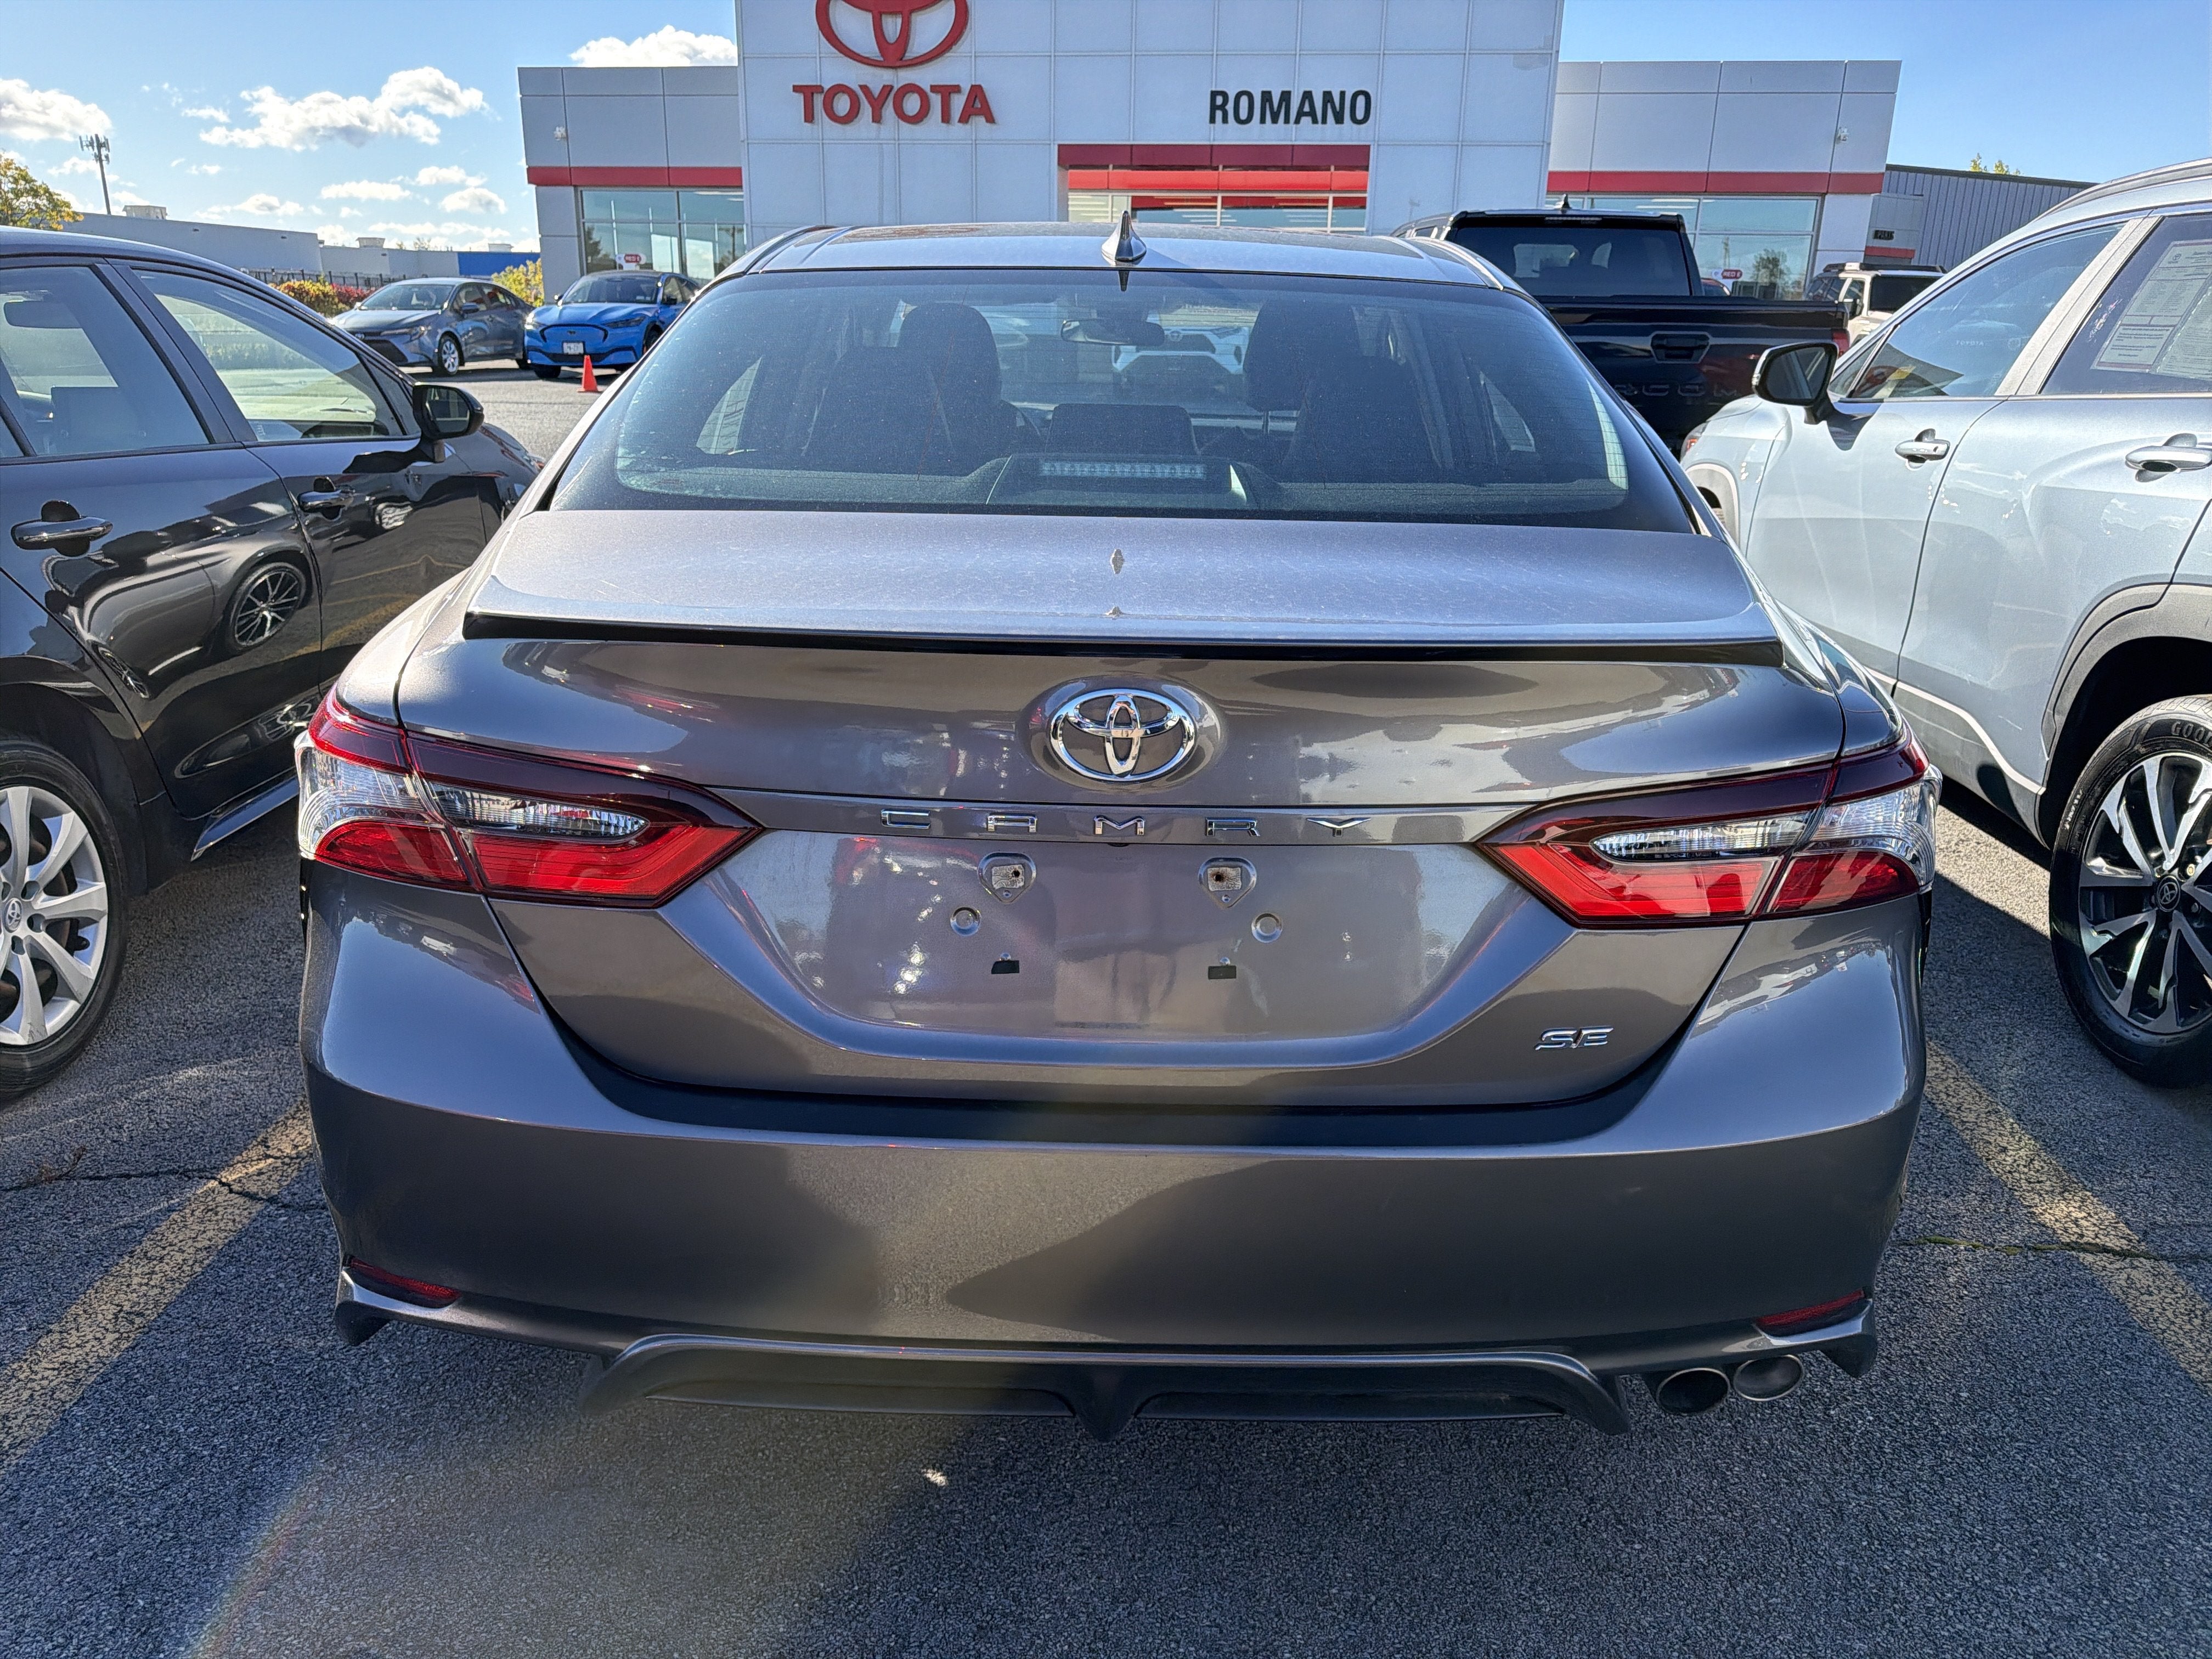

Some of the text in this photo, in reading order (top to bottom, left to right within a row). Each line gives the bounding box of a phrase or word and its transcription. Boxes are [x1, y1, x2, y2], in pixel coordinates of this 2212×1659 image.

[792, 83, 996, 125] TOYOTA
[1209, 89, 1372, 125] ROMANO
[881, 808, 1372, 838] CAMRY
[1534, 1025, 1614, 1050] SE
